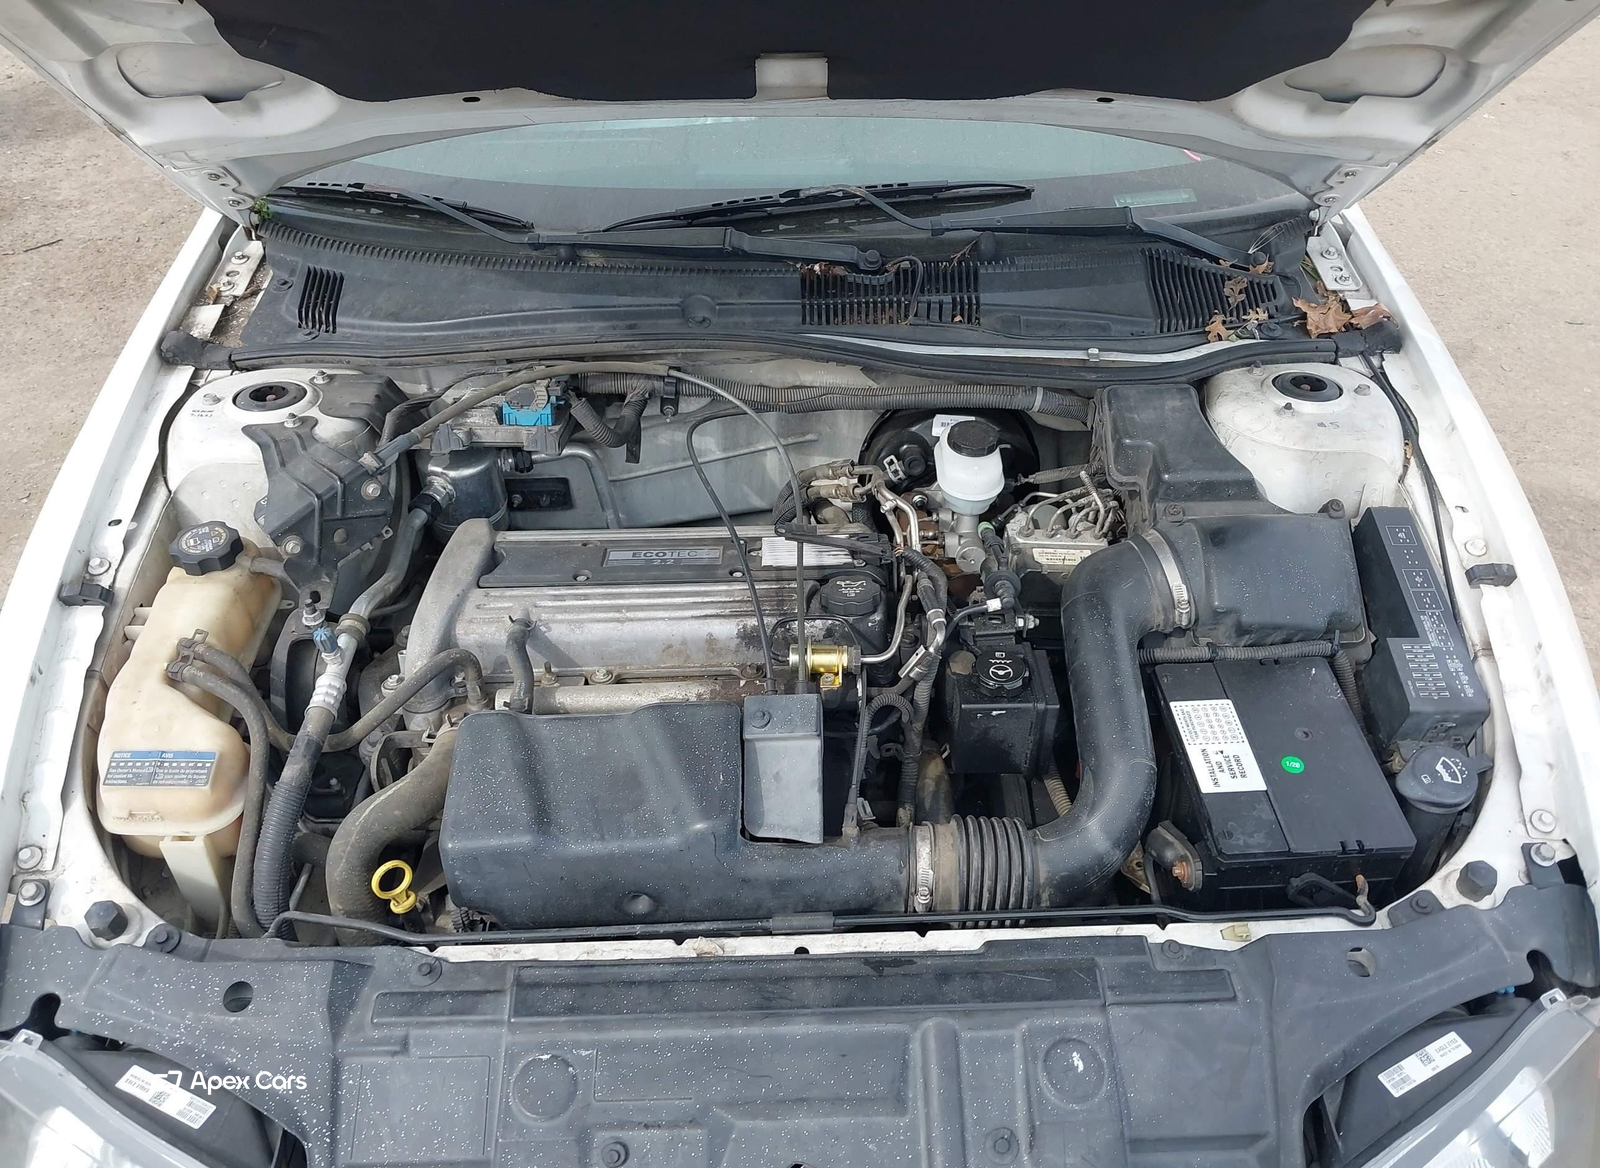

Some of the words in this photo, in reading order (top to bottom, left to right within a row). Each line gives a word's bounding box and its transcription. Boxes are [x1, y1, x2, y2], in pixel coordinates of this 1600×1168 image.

[631, 550, 698, 559] ECOTEC
[1200, 748, 1221, 787] INSTALLATION
[1215, 760, 1226, 773] AND
[1222, 754, 1238, 779] SERVICE
[1232, 754, 1248, 779] RECORD
